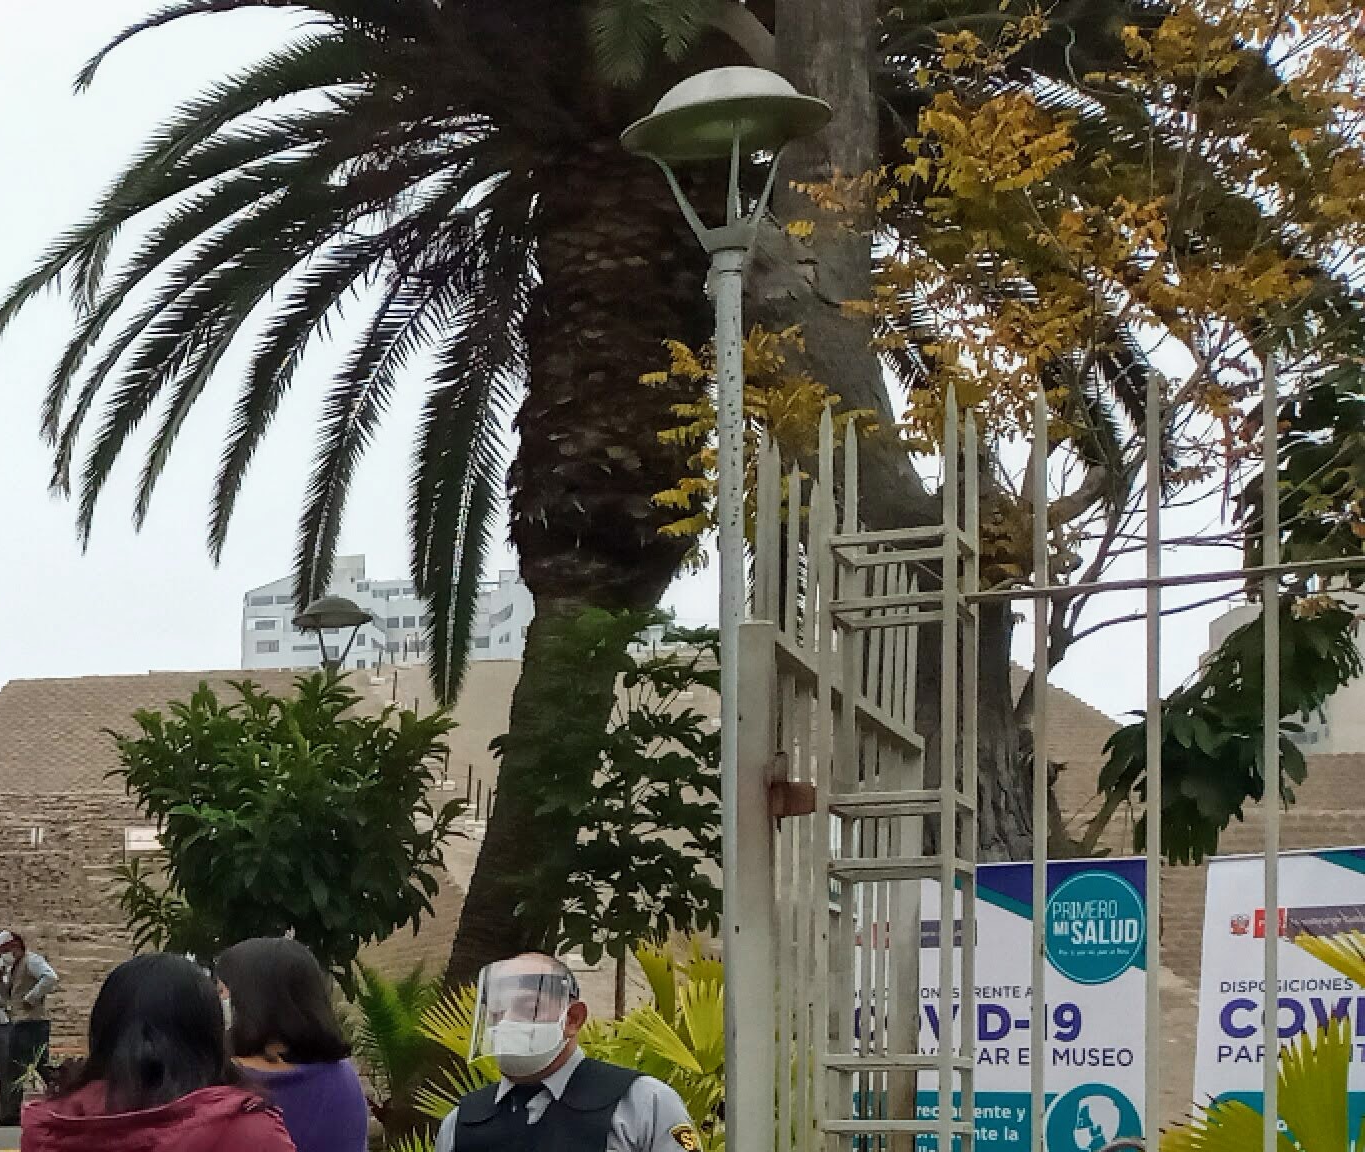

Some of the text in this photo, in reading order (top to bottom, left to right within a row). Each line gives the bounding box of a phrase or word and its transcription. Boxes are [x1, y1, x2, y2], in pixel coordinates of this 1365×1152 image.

[1052, 900, 1117, 918] PRIMERO
[1053, 919, 1138, 944] MI SALUD
[1052, 1047, 1133, 1066] MUSEO
[1016, 1107, 1026, 1122] y
[1004, 1125, 1020, 1142] la
